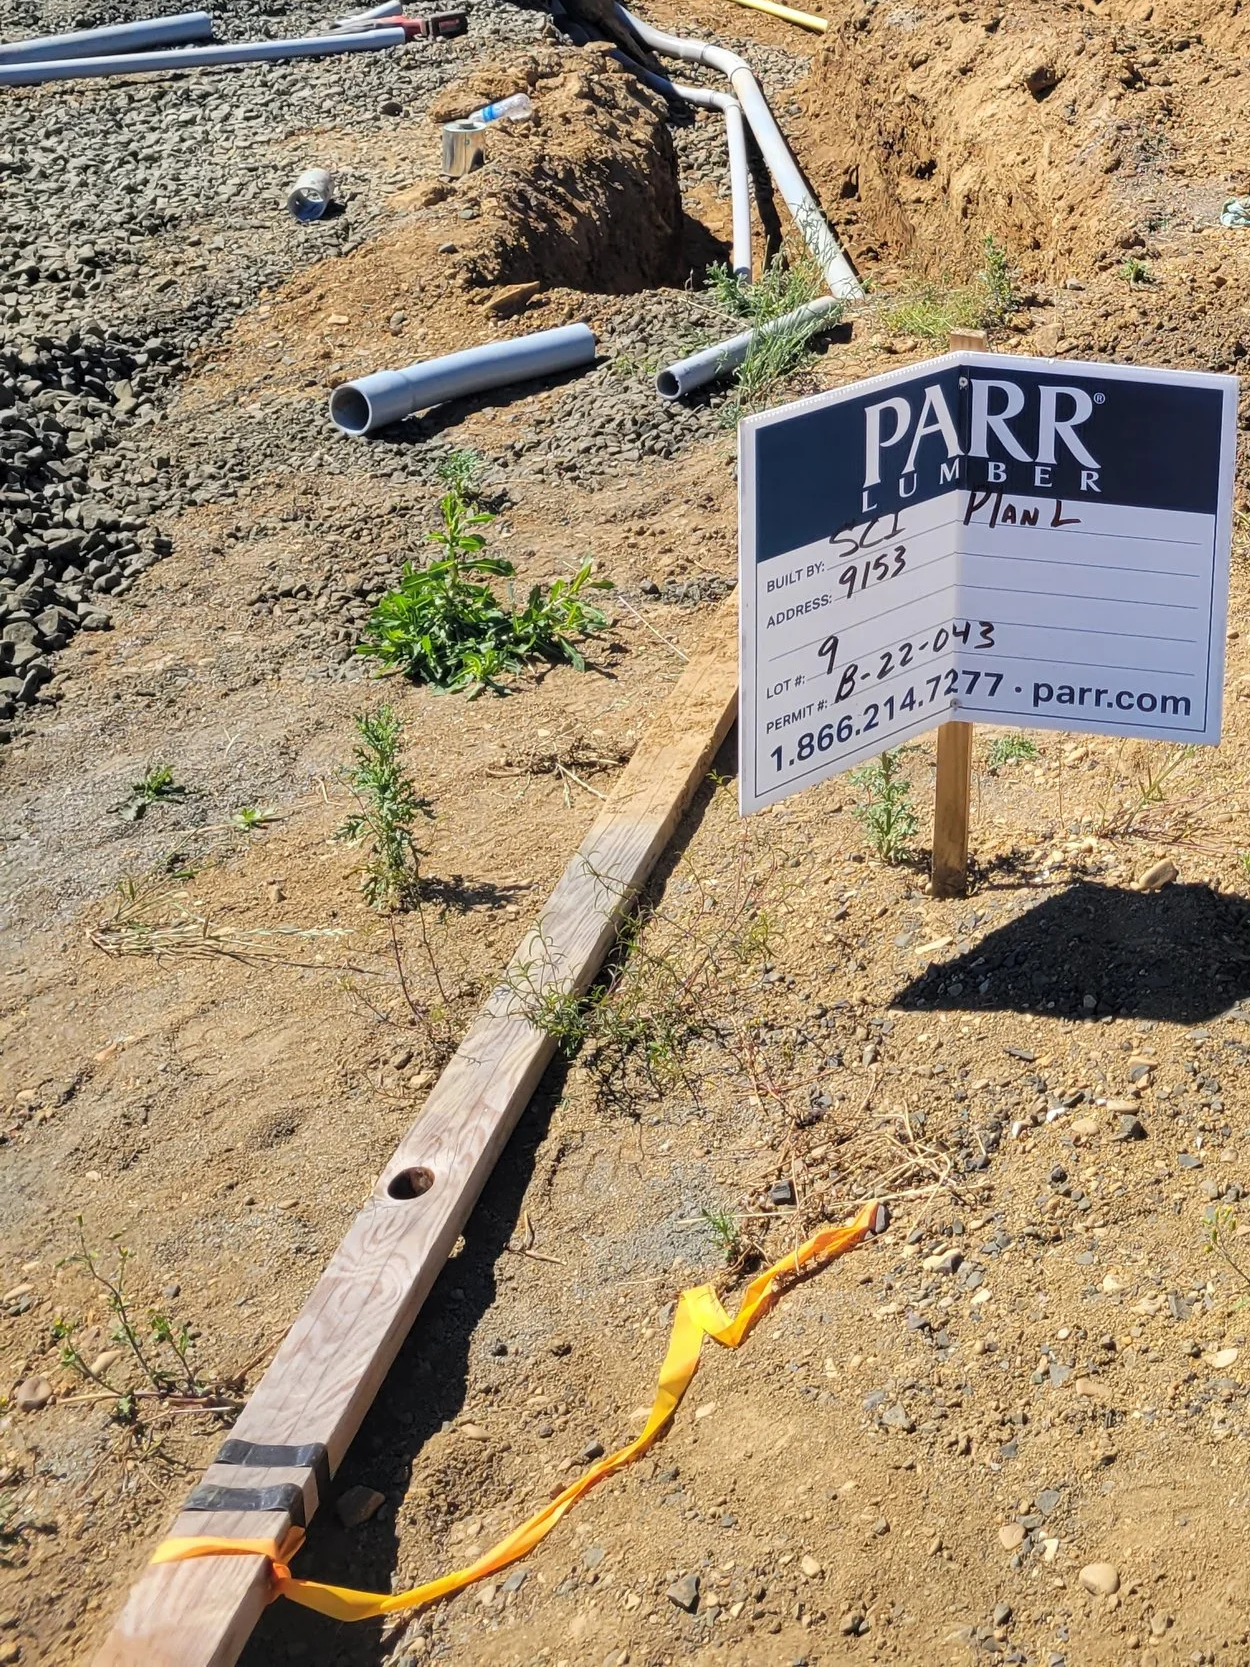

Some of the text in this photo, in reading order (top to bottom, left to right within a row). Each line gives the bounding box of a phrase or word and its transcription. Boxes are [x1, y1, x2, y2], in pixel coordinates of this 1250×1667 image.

[862, 378, 1102, 489] PARR
[861, 457, 1102, 513] LUMBER
[766, 561, 825, 593] BUILT BY:
[838, 545, 907, 599] 9153
[766, 594, 833, 629] ADDRESS:
[817, 634, 840, 675] 9
[835, 620, 996, 704] B-22-043
[766, 678, 792, 699] LOT
[766, 704, 814, 734] PERMIT
[770, 667, 1192, 772] 1.866.214.7277 parr.com
